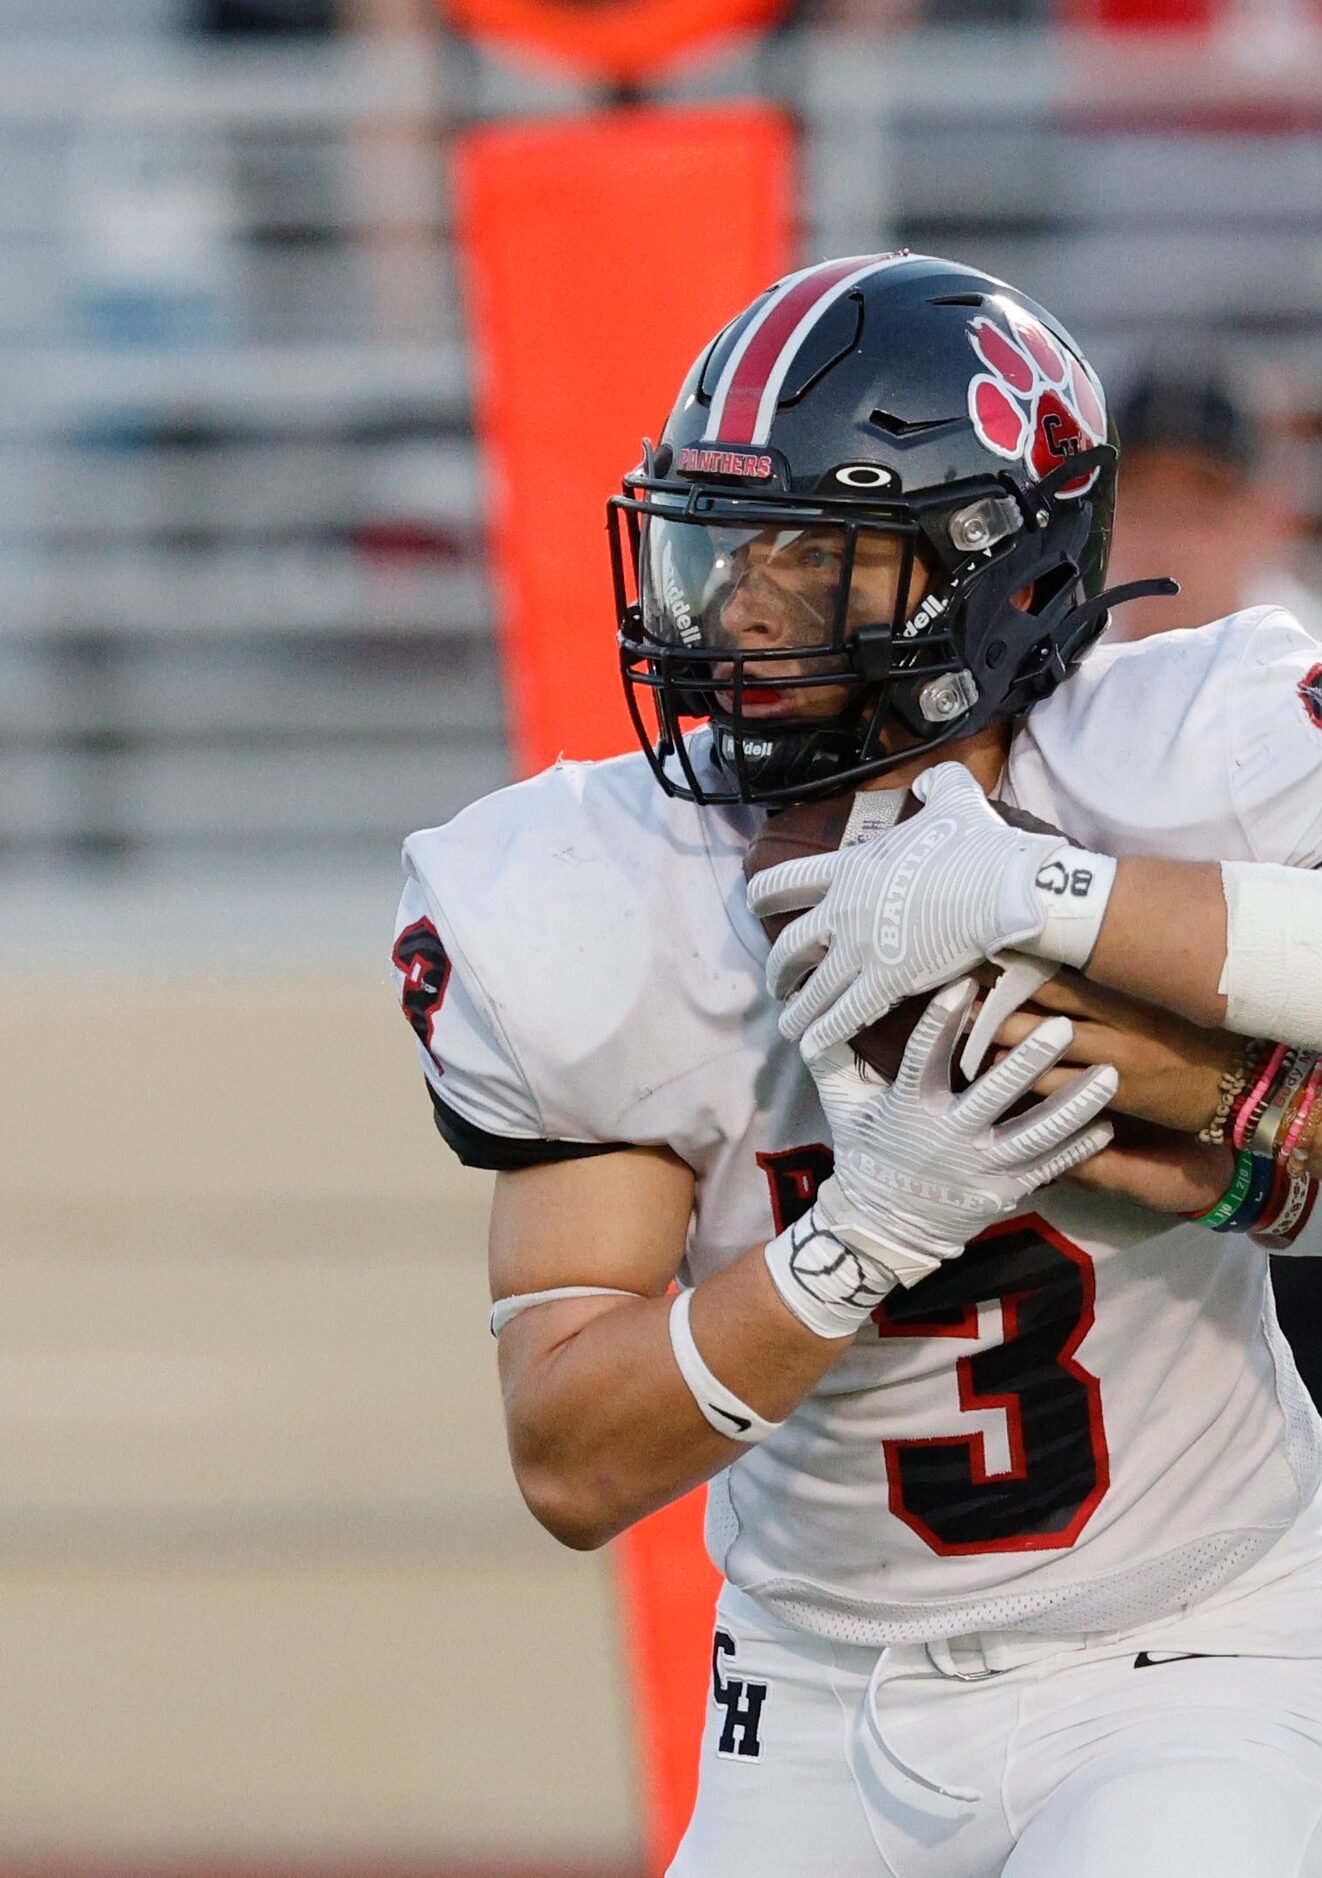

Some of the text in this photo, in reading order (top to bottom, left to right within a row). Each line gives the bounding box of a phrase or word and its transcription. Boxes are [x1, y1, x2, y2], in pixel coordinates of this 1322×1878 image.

[678, 448, 772, 478] PANTHERS
[879, 828, 945, 948] BATTLE
[858, 1151, 985, 1214] BATTLE
[871, 1211, 1110, 1556] 3
[711, 1627, 769, 1761] CH
